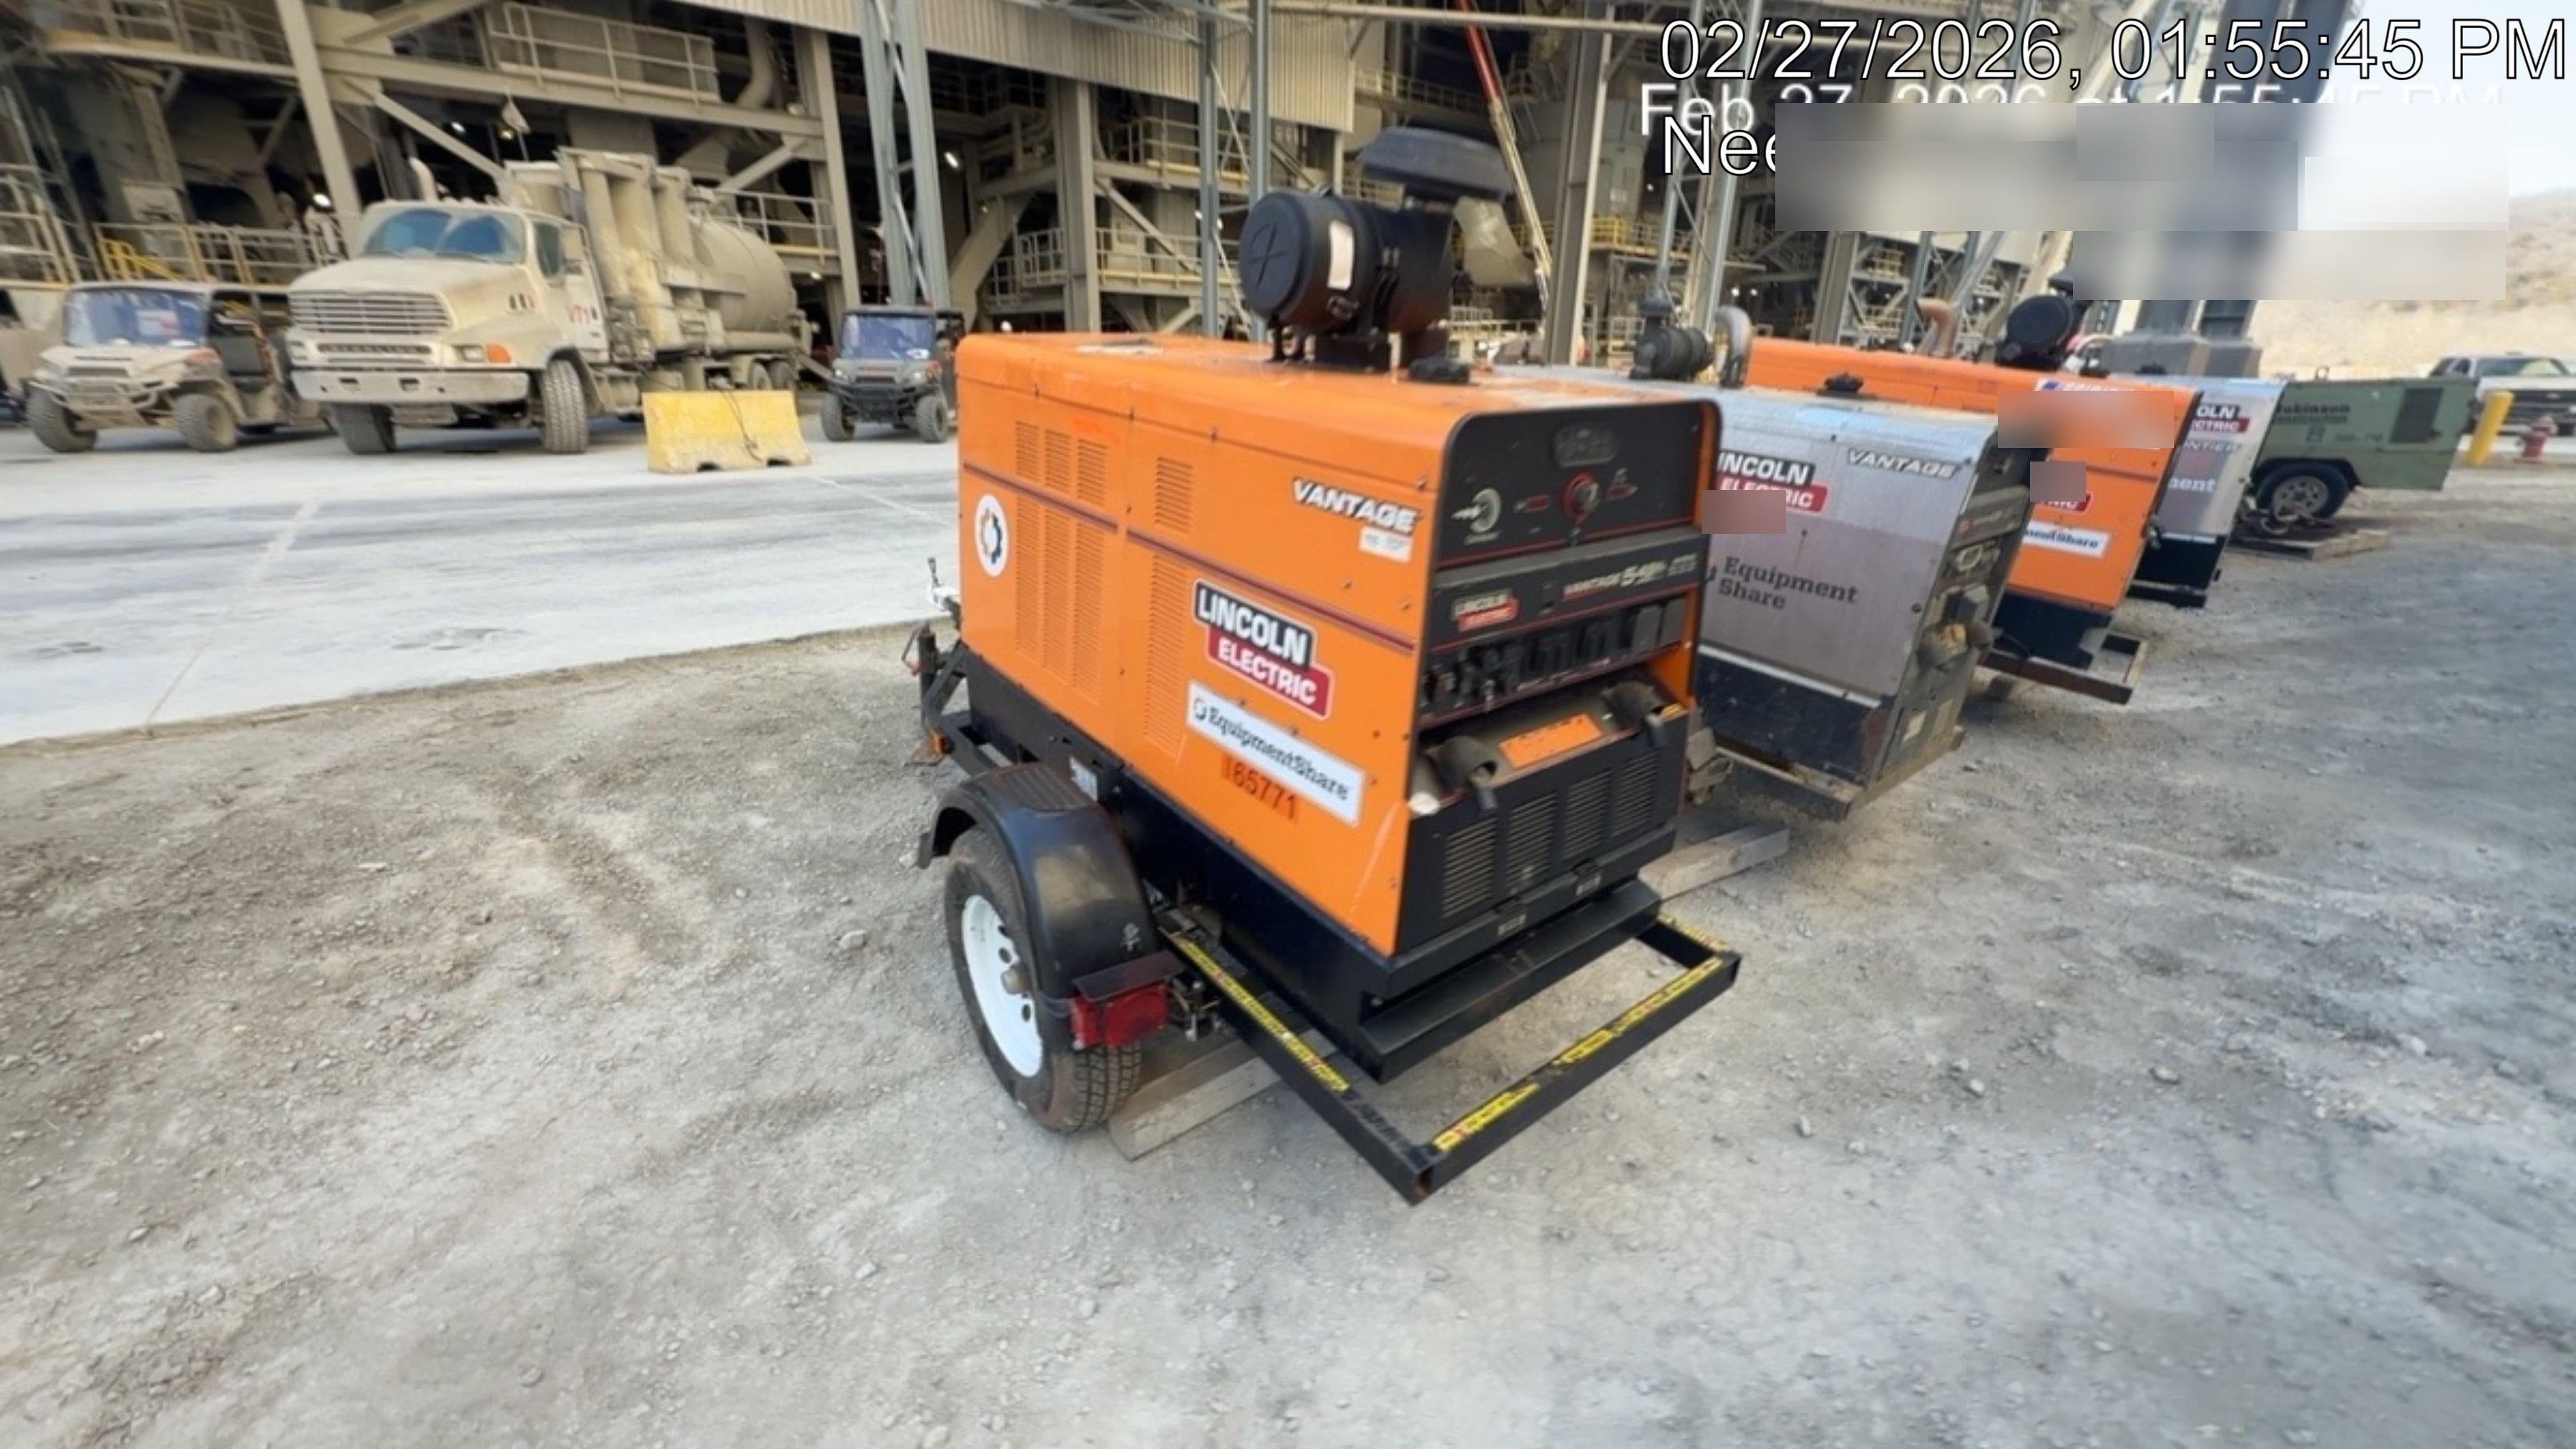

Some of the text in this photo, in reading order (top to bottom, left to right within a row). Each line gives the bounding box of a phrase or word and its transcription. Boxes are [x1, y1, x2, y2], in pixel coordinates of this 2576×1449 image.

[1717, 452, 1808, 487] INCOLN
[1849, 449, 1958, 479] VANTAGE
[1293, 477, 1420, 534] VANTAGE
[1719, 577, 1786, 610] Share
[1724, 555, 1858, 603] Equipment
[1198, 588, 1308, 665] LINCOLN
[1218, 637, 1317, 706] ELECTRIC
[1209, 706, 1350, 801] EquipmentShare
